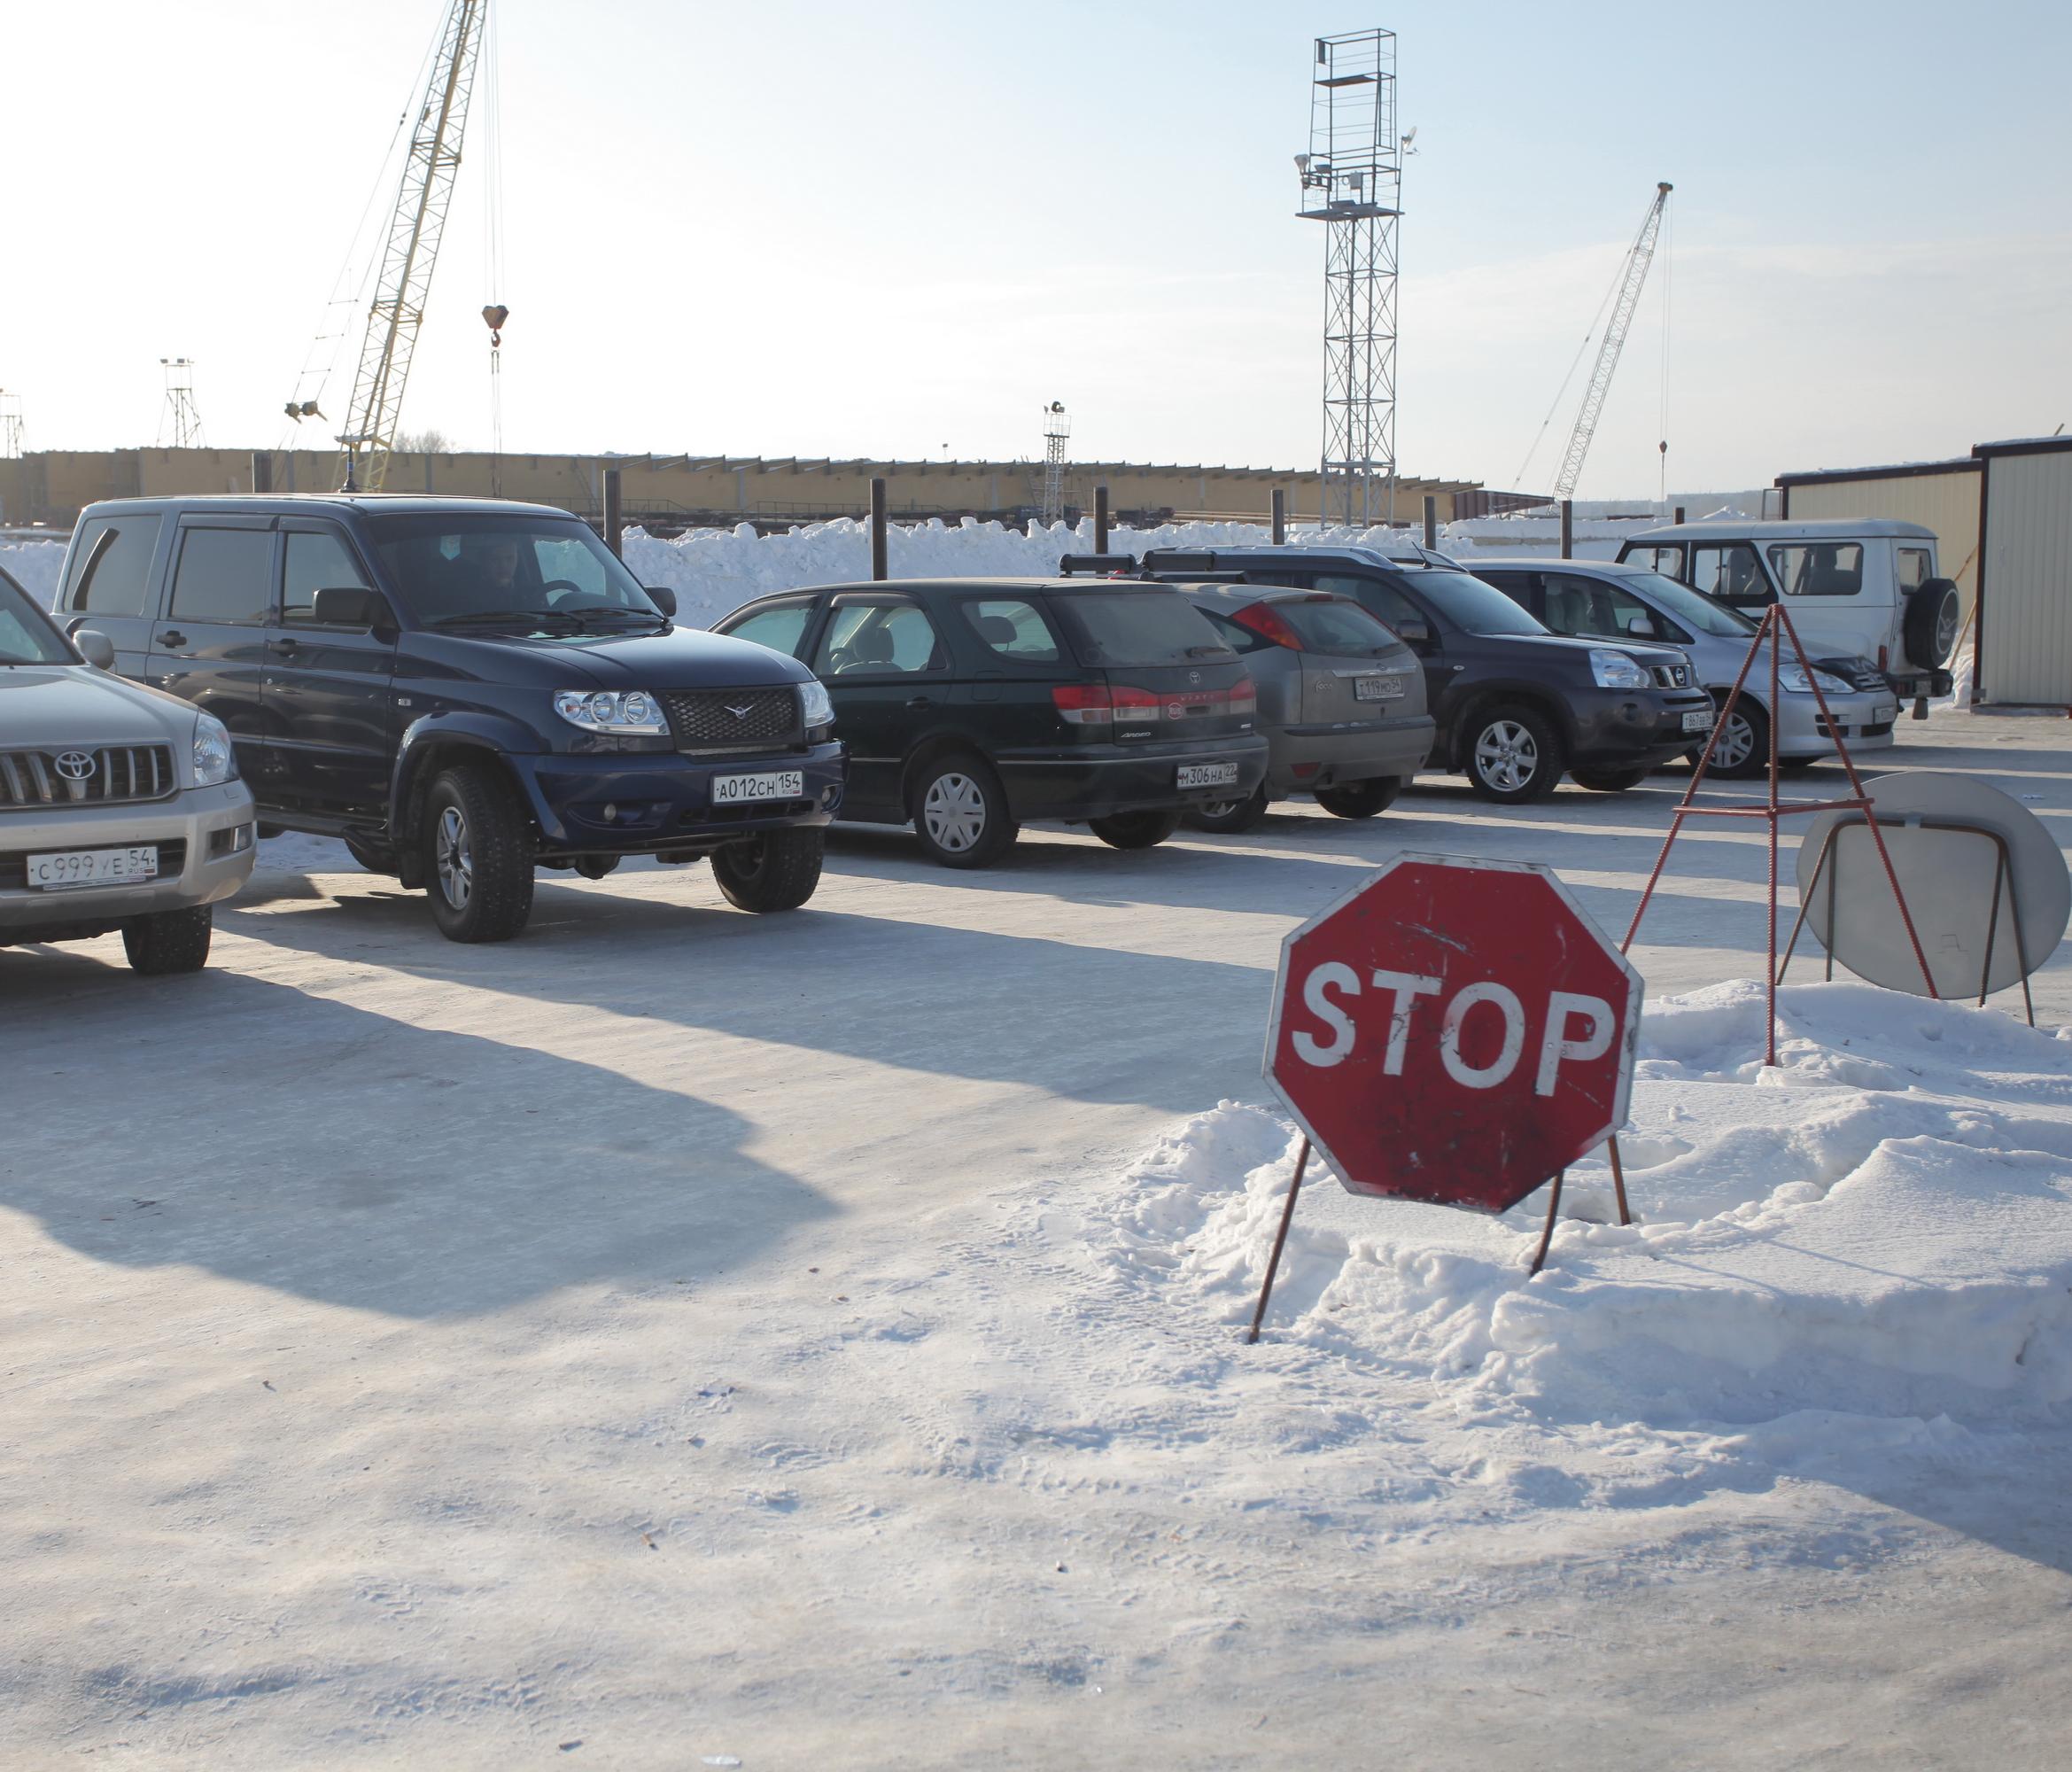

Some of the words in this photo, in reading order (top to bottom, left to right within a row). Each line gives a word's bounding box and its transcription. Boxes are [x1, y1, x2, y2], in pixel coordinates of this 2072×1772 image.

[719, 778, 776, 799] A012CH
[779, 773, 801, 789] 154
[129, 849, 151, 867] 54
[1291, 960, 1617, 1098] STOP
